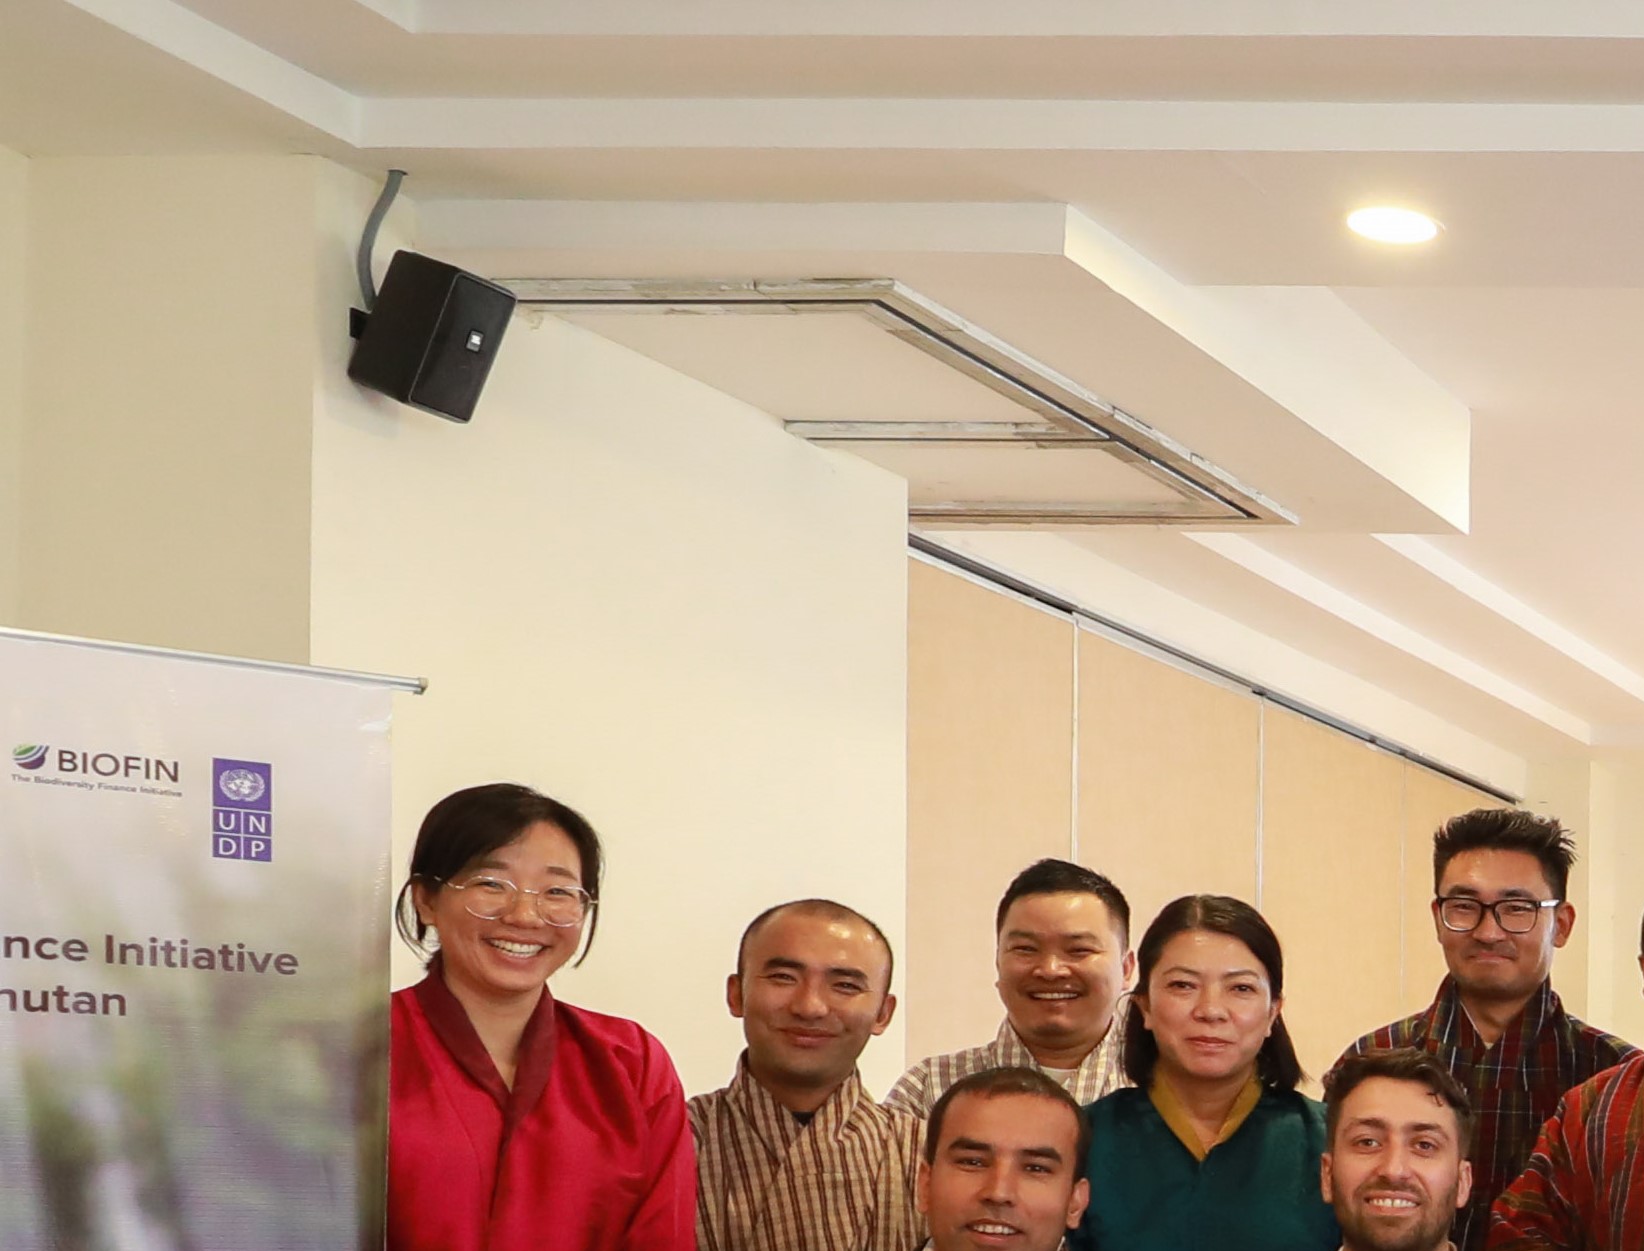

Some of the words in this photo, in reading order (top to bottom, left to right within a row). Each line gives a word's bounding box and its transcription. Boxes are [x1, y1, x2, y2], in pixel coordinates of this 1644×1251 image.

[58, 749, 179, 783] BIOFIN
[11, 773, 31, 783] The
[34, 776, 95, 791] Biodiversity
[98, 782, 137, 793] Finance
[140, 786, 183, 798] Initiative
[105, 934, 299, 976] Initiative
